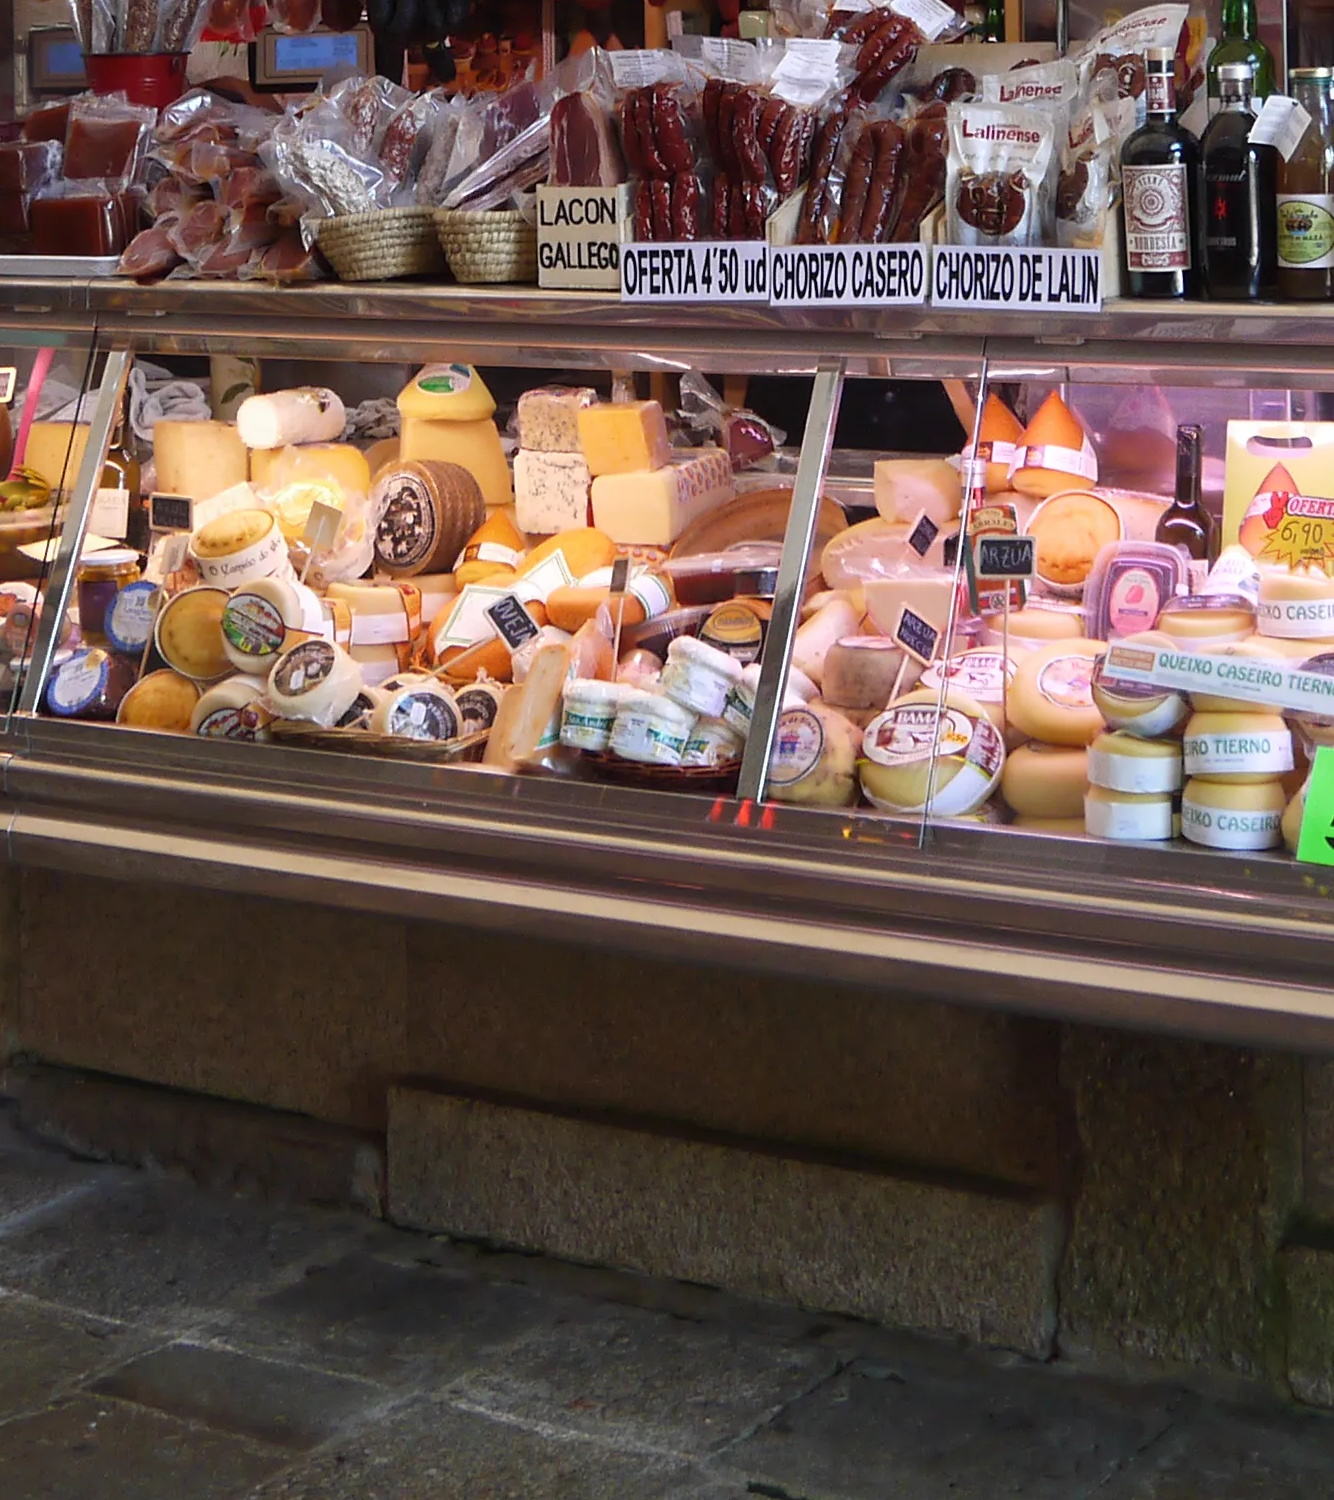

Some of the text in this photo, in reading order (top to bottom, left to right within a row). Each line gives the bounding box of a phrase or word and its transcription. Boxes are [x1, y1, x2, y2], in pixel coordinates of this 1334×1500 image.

[962, 119, 1041, 144] Lalinense
[539, 197, 616, 227] LACON
[539, 241, 620, 270] GALLEGO
[623, 247, 698, 297] OFERTA
[772, 249, 924, 300] CHORIZO CASERO
[936, 254, 1100, 305] CHORIZO DE LALIN
[1158, 652, 1213, 675] QUEIXO
[1217, 663, 1283, 687] CASEIRO
[1184, 737, 1272, 757] EIRO TIERNO
[1216, 810, 1281, 832] CASEIRO
